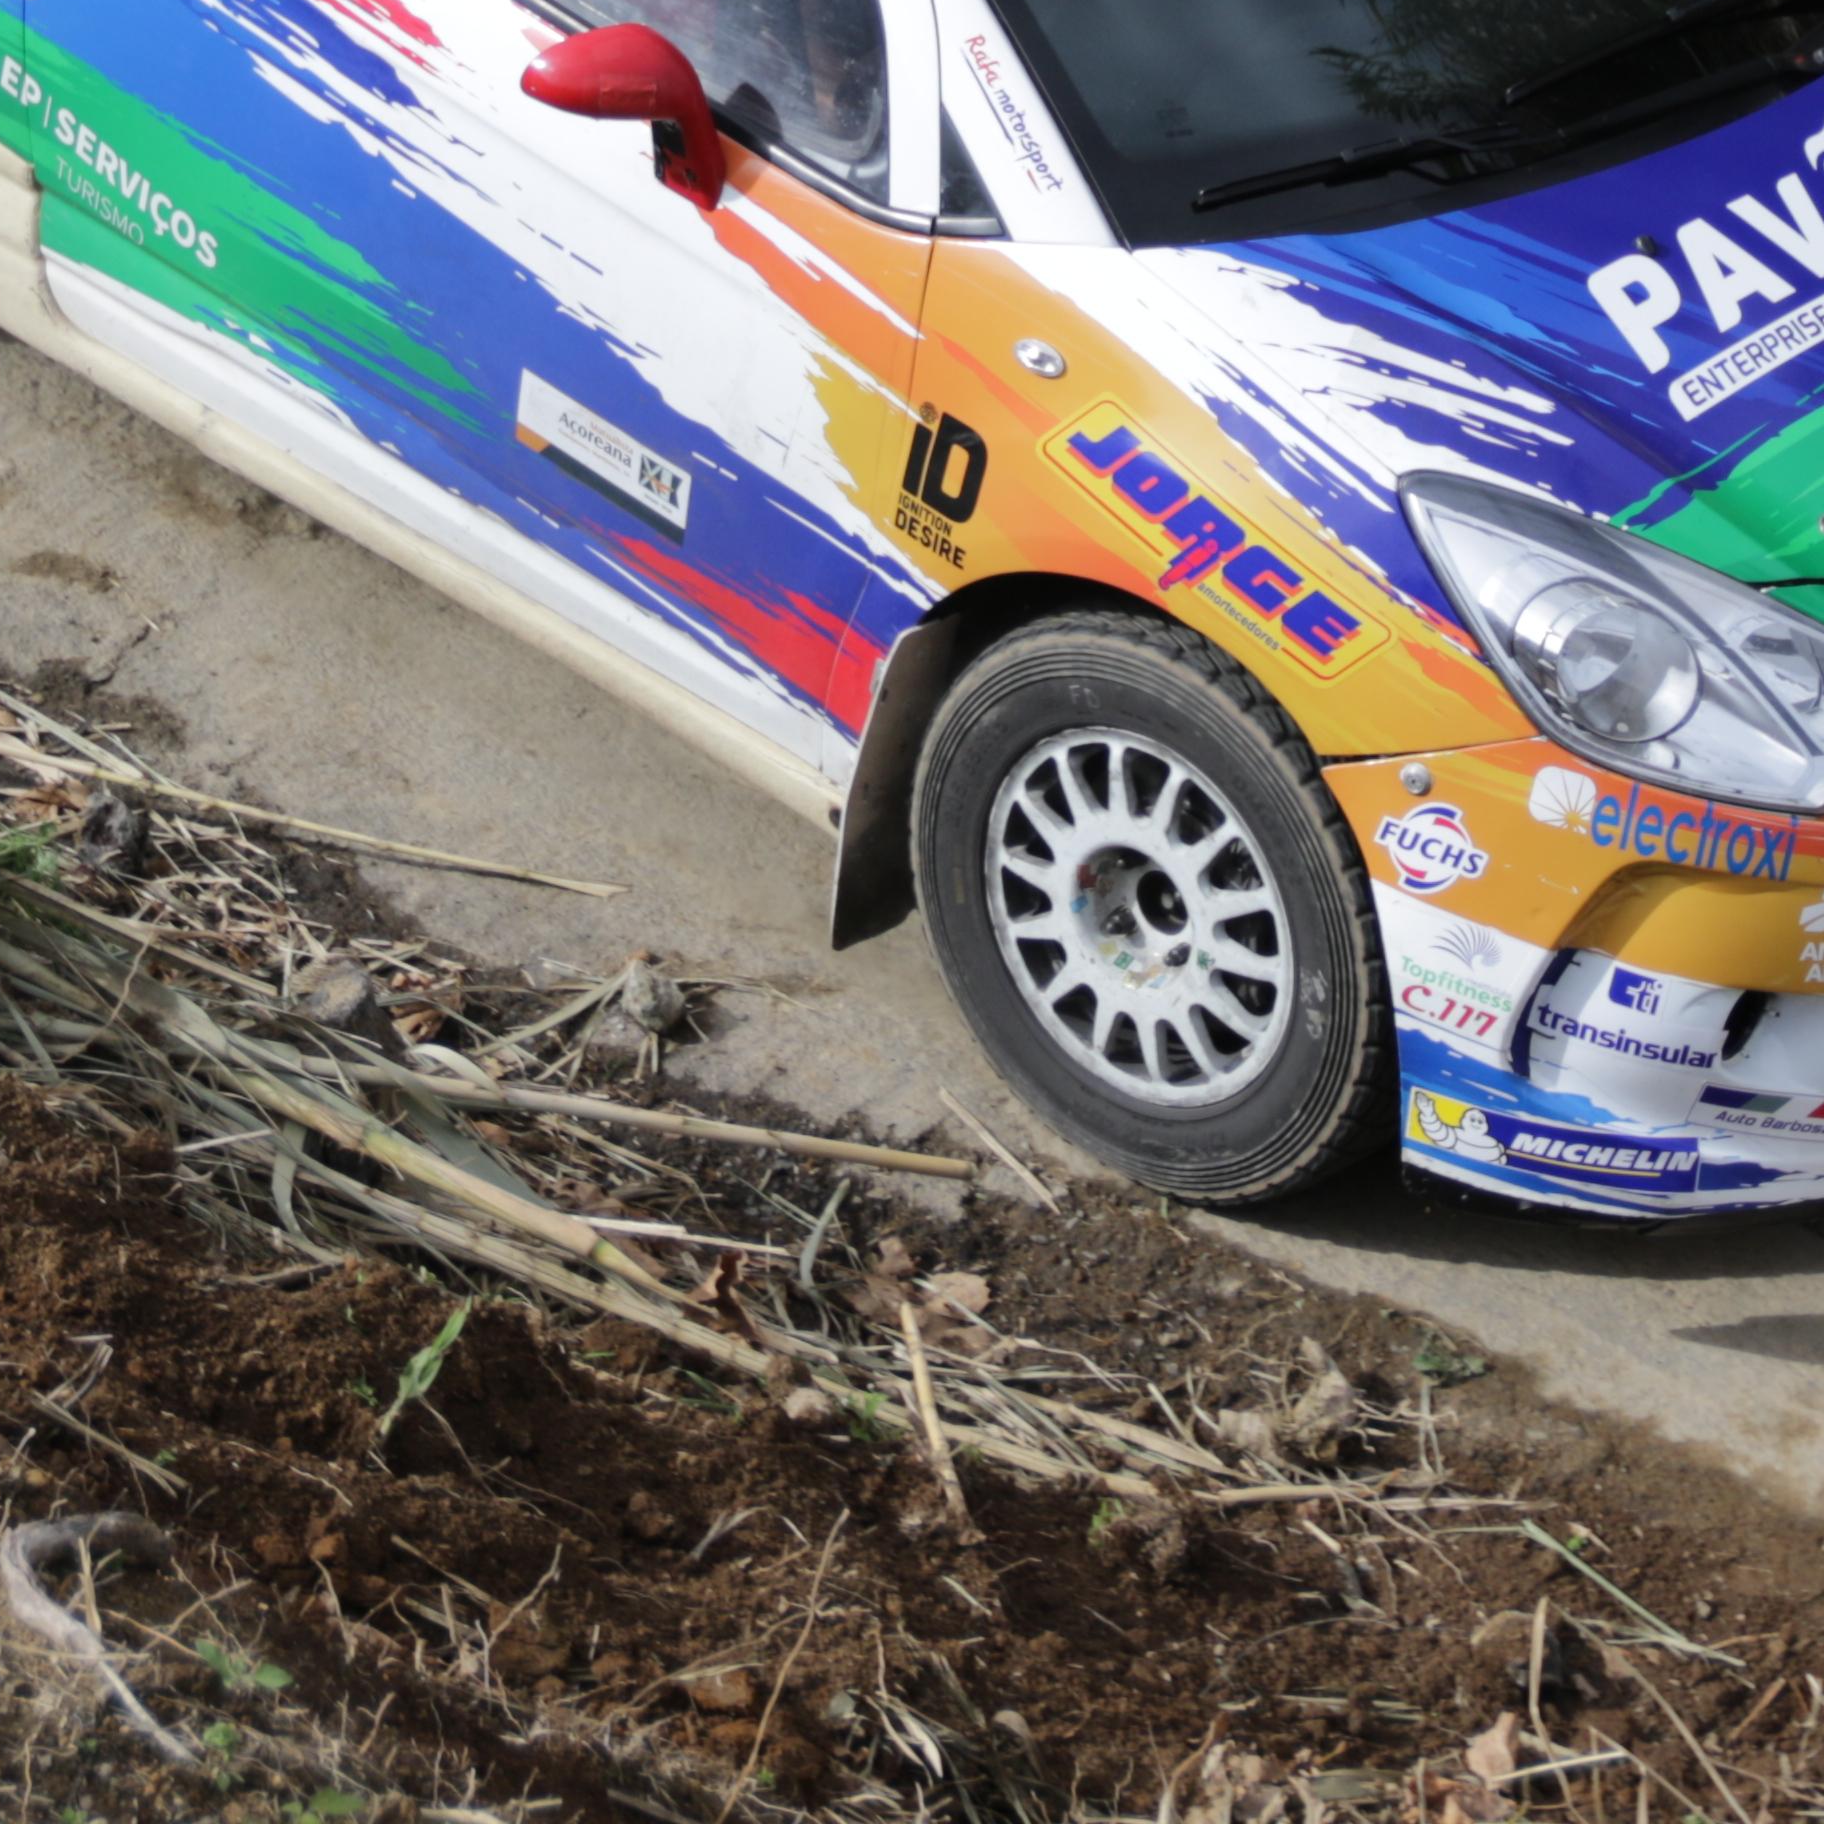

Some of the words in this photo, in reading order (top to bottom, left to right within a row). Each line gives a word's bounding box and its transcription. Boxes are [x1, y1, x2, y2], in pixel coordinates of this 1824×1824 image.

[965, 34, 1000, 88] Rafa
[994, 88, 1063, 192] motorsport
[0, 56, 41, 107] EP
[55, 108, 218, 268] SERVIÇOS
[54, 155, 144, 246] TURISMO
[559, 412, 633, 469] Açoreana
[895, 507, 966, 570] DESIRE
[899, 493, 952, 537] IGNITION
[1066, 425, 1361, 665] JORGE
[1196, 581, 1281, 652] amortecedores
[1379, 821, 1485, 875] FUCHS
[1591, 783, 1800, 882] electroxi
[1402, 956, 1512, 1012] Topfitness
[1402, 985, 1497, 1036] C.117
[1537, 1004, 1717, 1068] transinsular
[1715, 1111, 1756, 1126] Auto
[1510, 1133, 1697, 1171] MICHELIN
